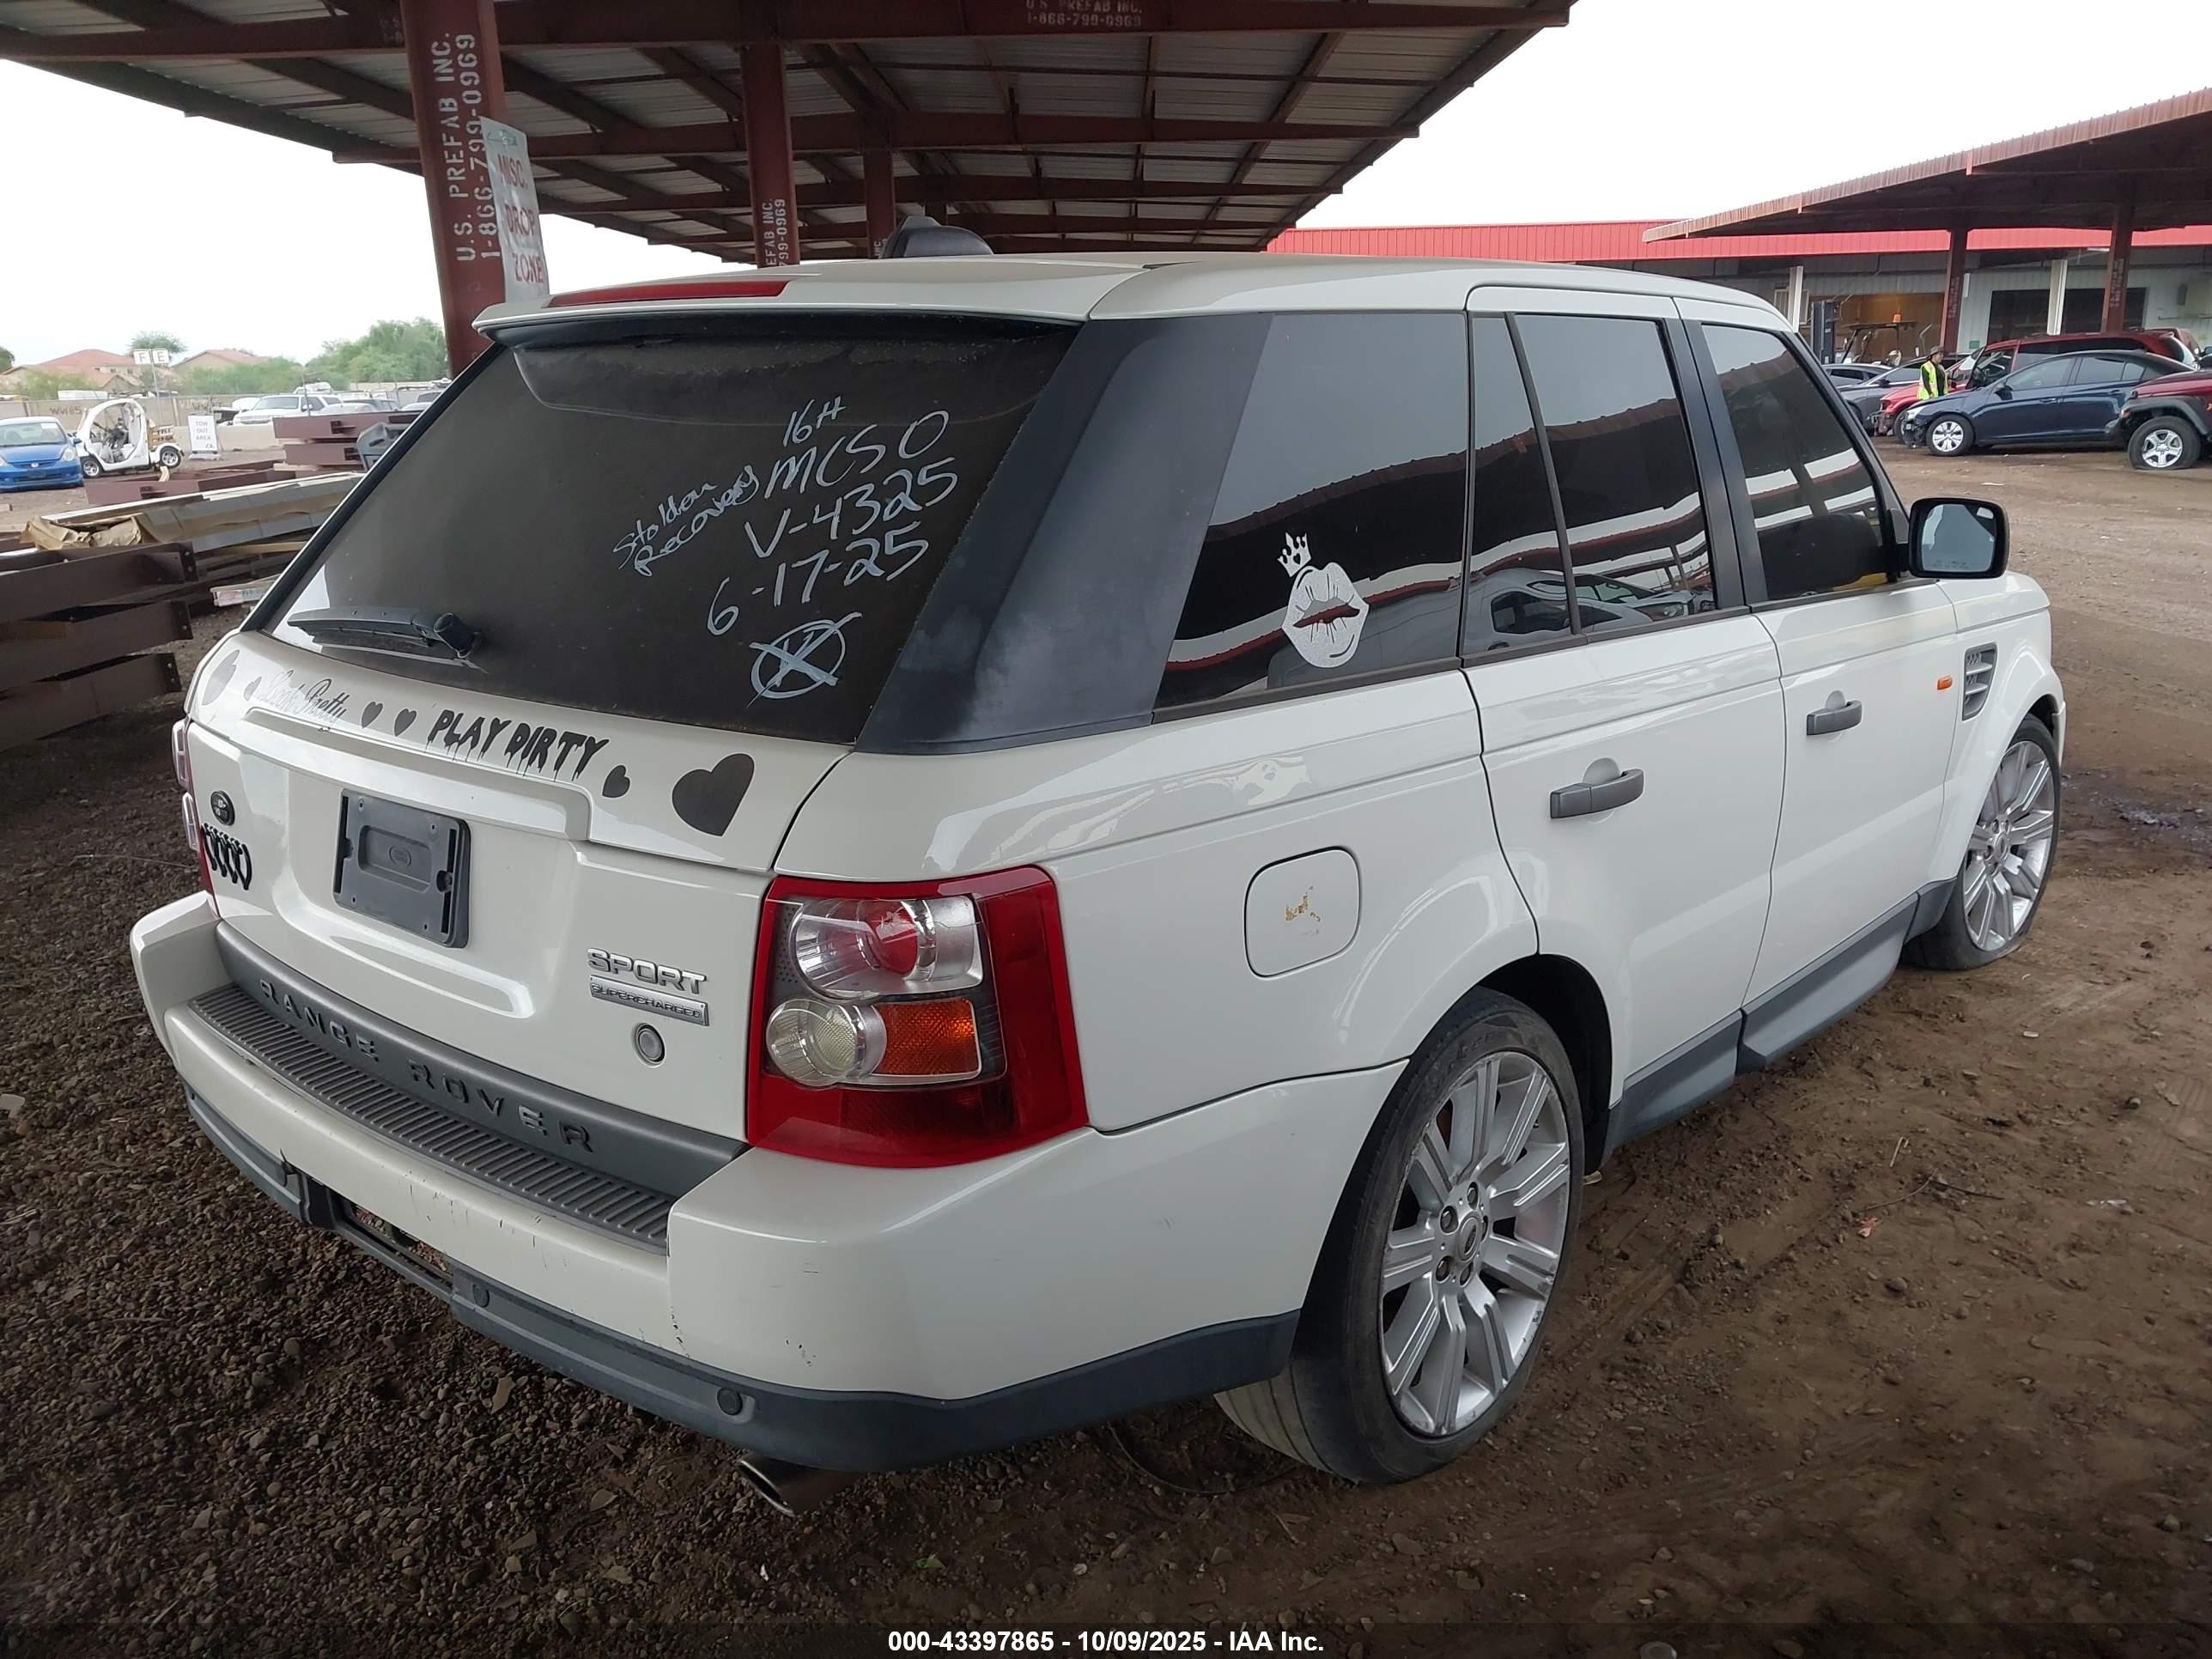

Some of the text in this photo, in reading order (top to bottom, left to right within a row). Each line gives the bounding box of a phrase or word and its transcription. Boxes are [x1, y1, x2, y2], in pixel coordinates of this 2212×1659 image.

[1058, 0, 1111, 13] PREFAB
[430, 32, 477, 261] U.S. PREFAB INC.
[455, 33, 501, 258] 1-866-799-0969
[505, 204, 536, 236] DROP
[512, 252, 544, 283] ZONE
[157, 351, 165, 362] E
[744, 457, 958, 558] V-4325
[707, 520, 929, 635] 6-17-25
[425, 708, 611, 782] PLAY DIRTY
[587, 947, 708, 994] SPORT
[259, 979, 594, 1154] RANGE ROVER
